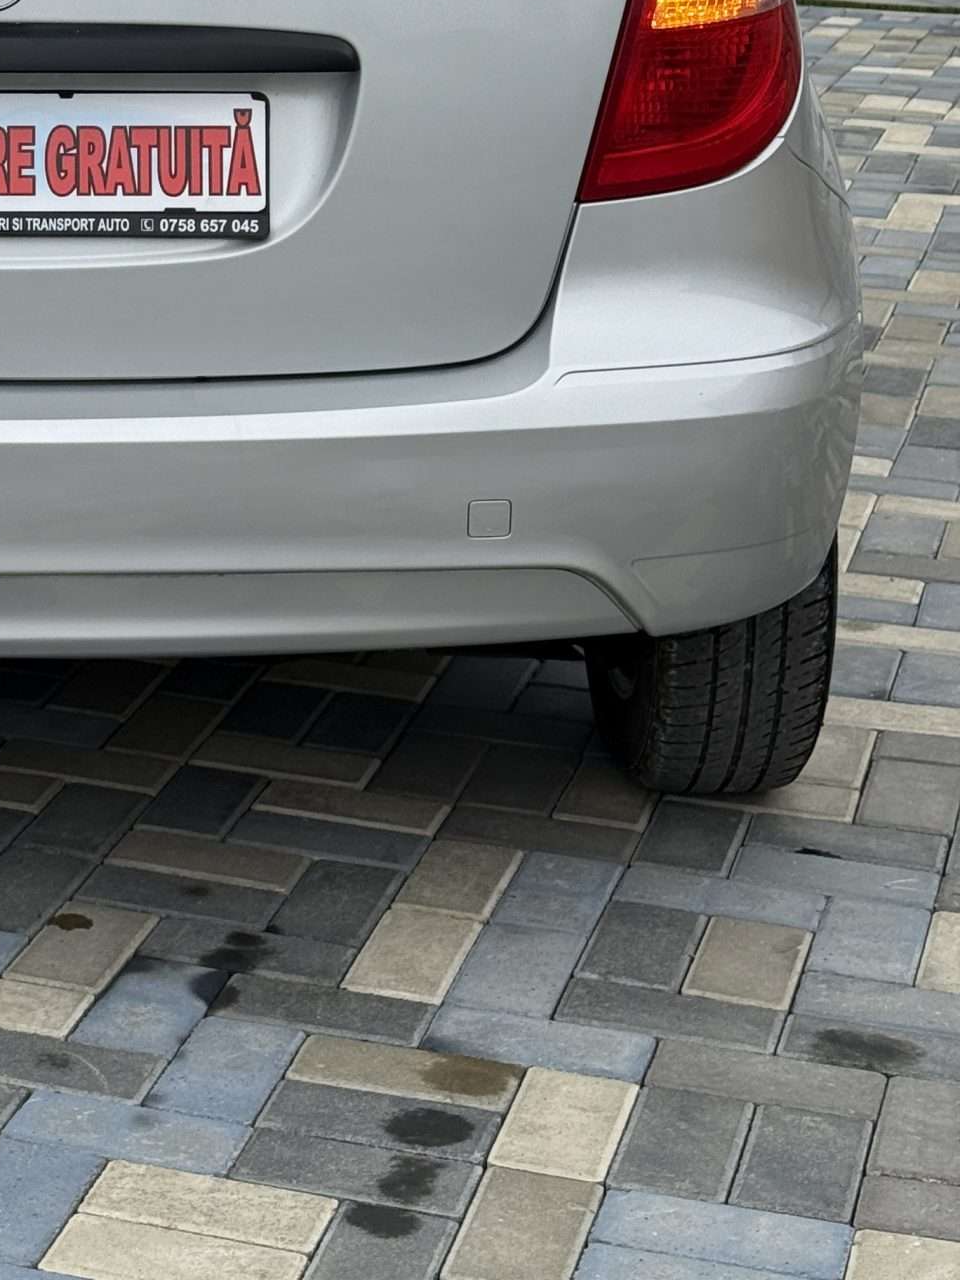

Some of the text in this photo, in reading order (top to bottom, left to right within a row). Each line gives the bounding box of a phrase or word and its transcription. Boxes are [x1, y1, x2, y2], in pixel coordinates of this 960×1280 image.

[44, 108, 262, 197] GRATUITĂ
[12, 217, 24, 231] SI
[25, 218, 95, 231] TRANSPORT
[97, 218, 130, 232] AUTO
[159, 218, 196, 232] 0758
[200, 219, 227, 232] 657
[231, 219, 259, 233] 045
